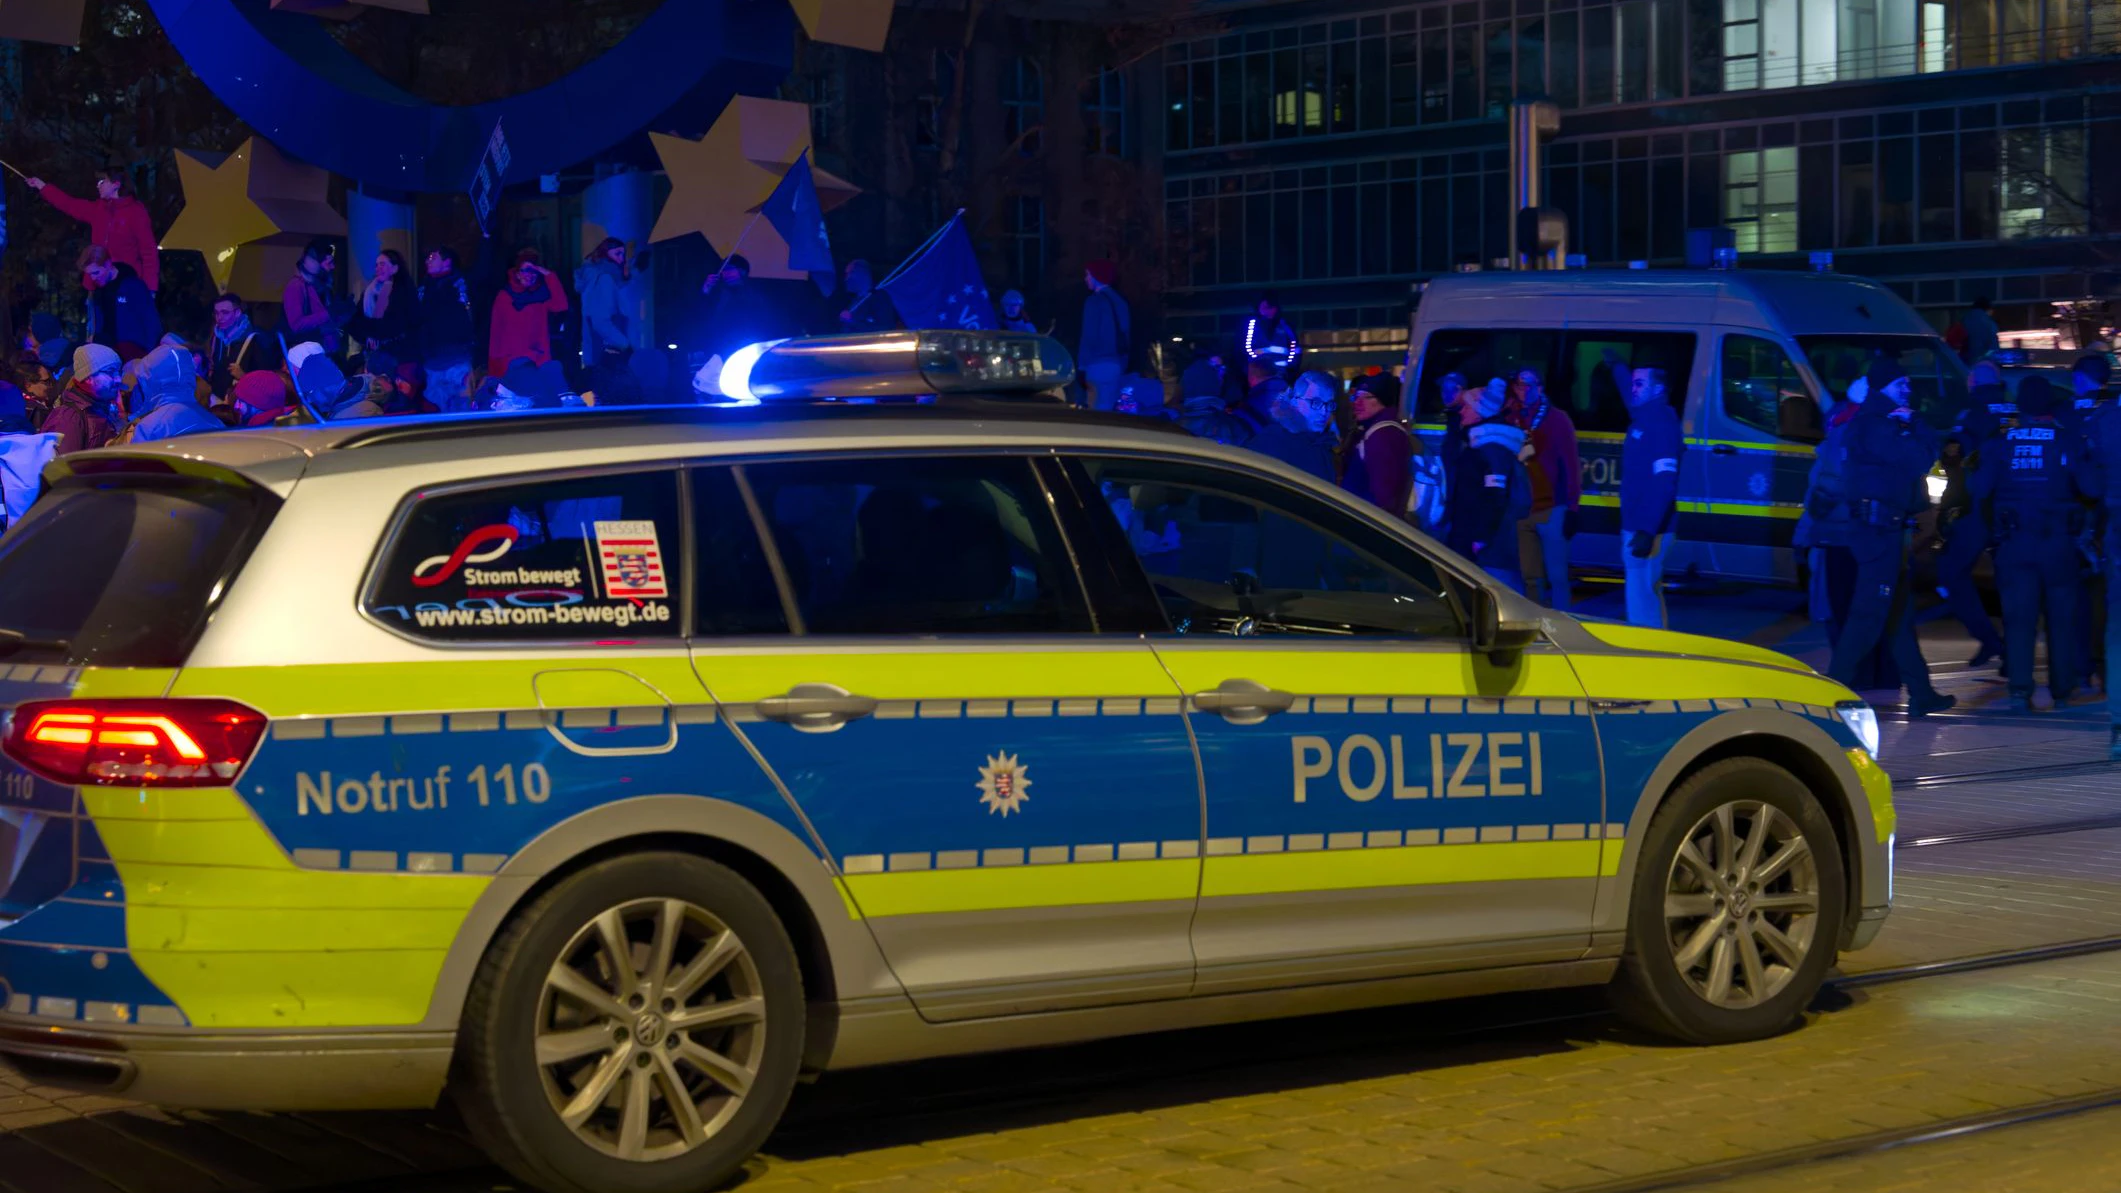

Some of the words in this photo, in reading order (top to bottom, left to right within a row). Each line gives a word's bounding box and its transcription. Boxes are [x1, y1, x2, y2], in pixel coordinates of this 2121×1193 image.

[2006, 427, 2055, 441] POLIZEI
[596, 522, 655, 536] HESSEN
[464, 567, 518, 585] Strom
[519, 567, 581, 588] bewegt
[415, 603, 670, 628] www.strom-bewegt.de
[1291, 732, 1542, 803] POLIZEI
[6, 772, 34, 800] 110
[296, 765, 453, 816] Notruf
[466, 762, 552, 807] 110
